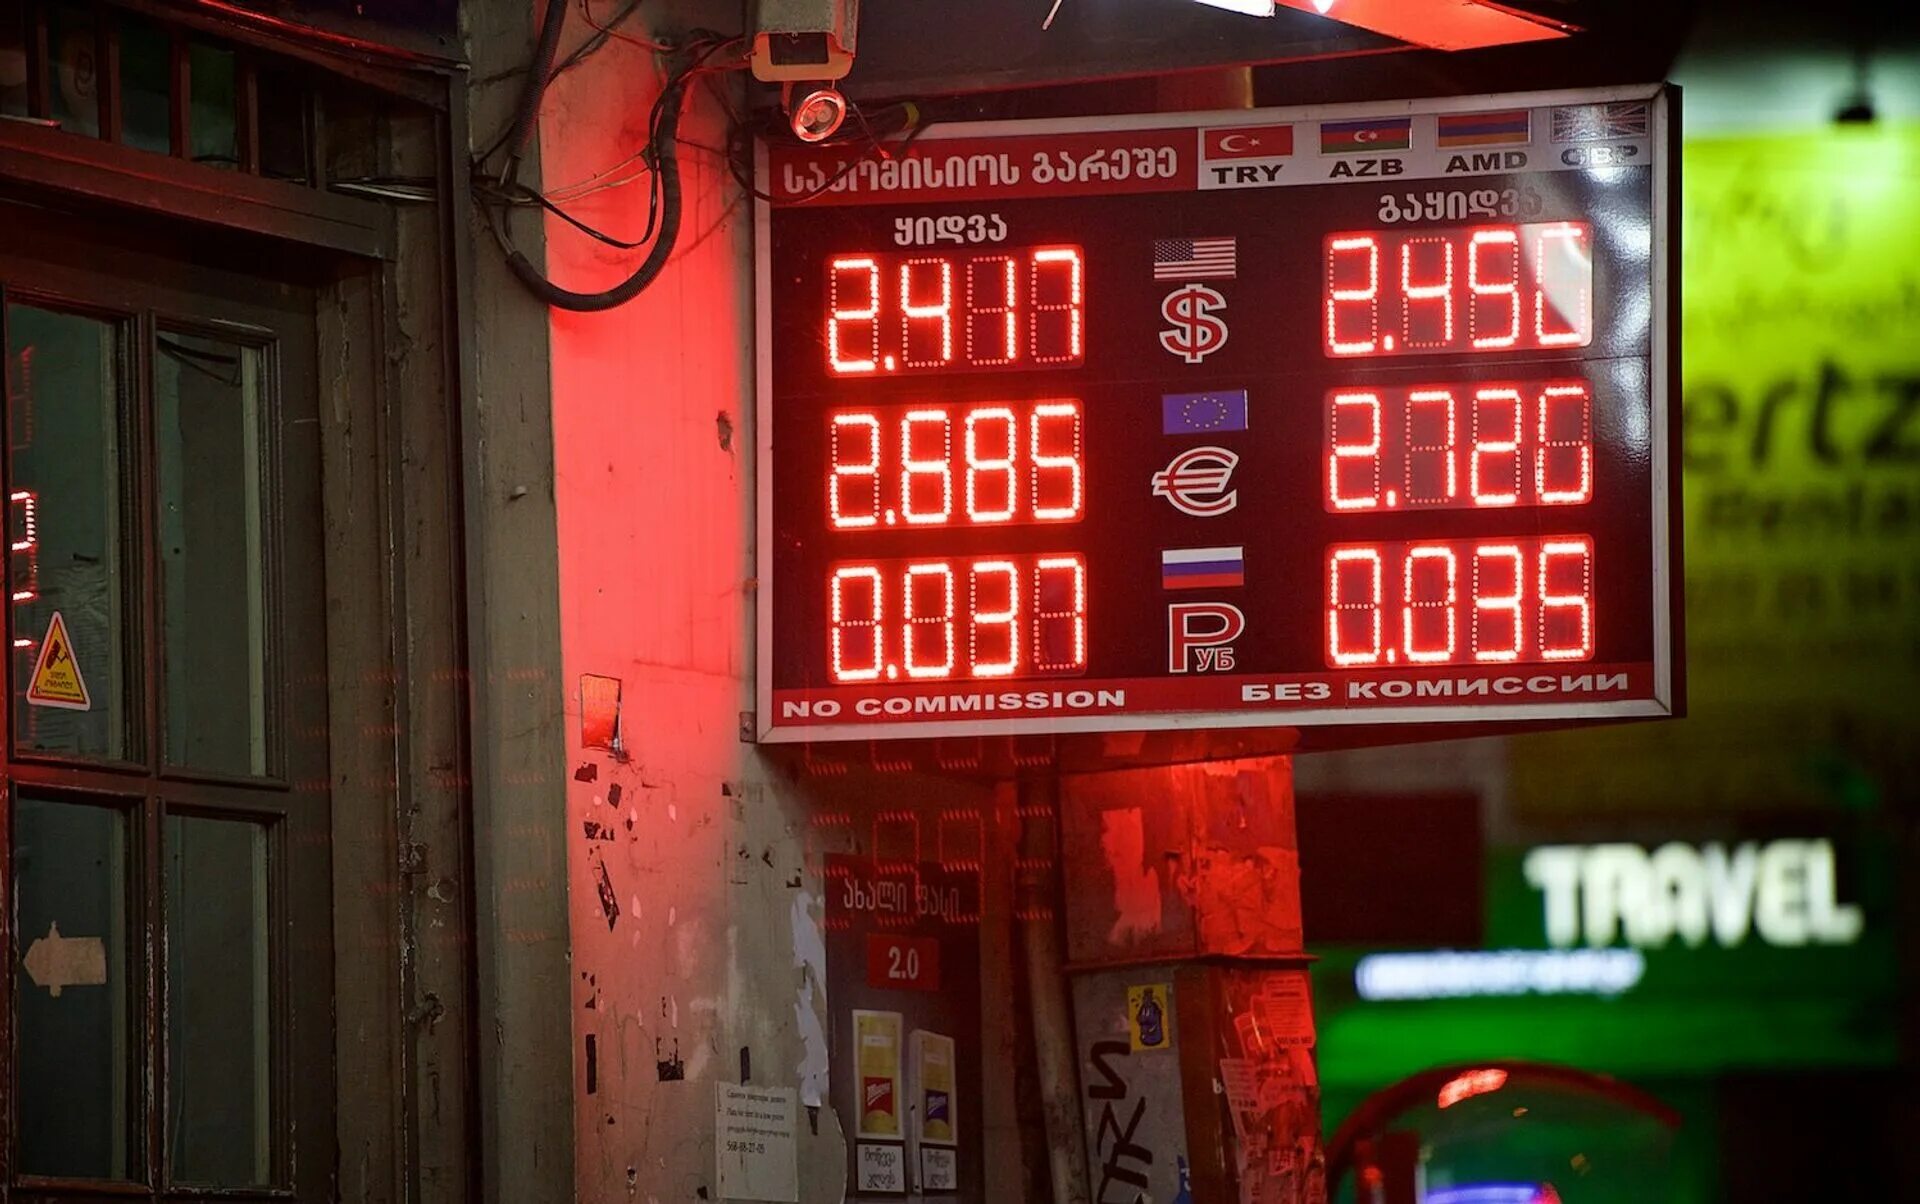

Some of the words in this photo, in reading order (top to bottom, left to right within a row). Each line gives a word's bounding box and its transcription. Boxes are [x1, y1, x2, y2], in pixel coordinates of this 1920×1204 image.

[1032, 145, 1177, 182] გარეშე
[1211, 164, 1284, 185] TRY
[1329, 158, 1404, 179] AZB
[1445, 150, 1528, 174] AMD
[1378, 187, 1543, 223] გაყიდვა
[894, 213, 1008, 246] ყიდვა
[829, 250, 1080, 373] 2.417
[1683, 355, 1920, 478] ertz
[829, 404, 1081, 528] 2.685
[1330, 387, 1590, 509] 2.720
[831, 558, 1083, 681] 0.037
[1330, 543, 1590, 663] 0.035
[782, 699, 841, 719] NO
[854, 689, 1126, 716] COMMISSION
[1242, 683, 1331, 702] БЕЗ
[1348, 673, 1628, 699] КОМИССИИ
[843, 877, 907, 913] ახალი
[1524, 838, 1864, 948] TRAVEL
[888, 946, 919, 980] 2.0
